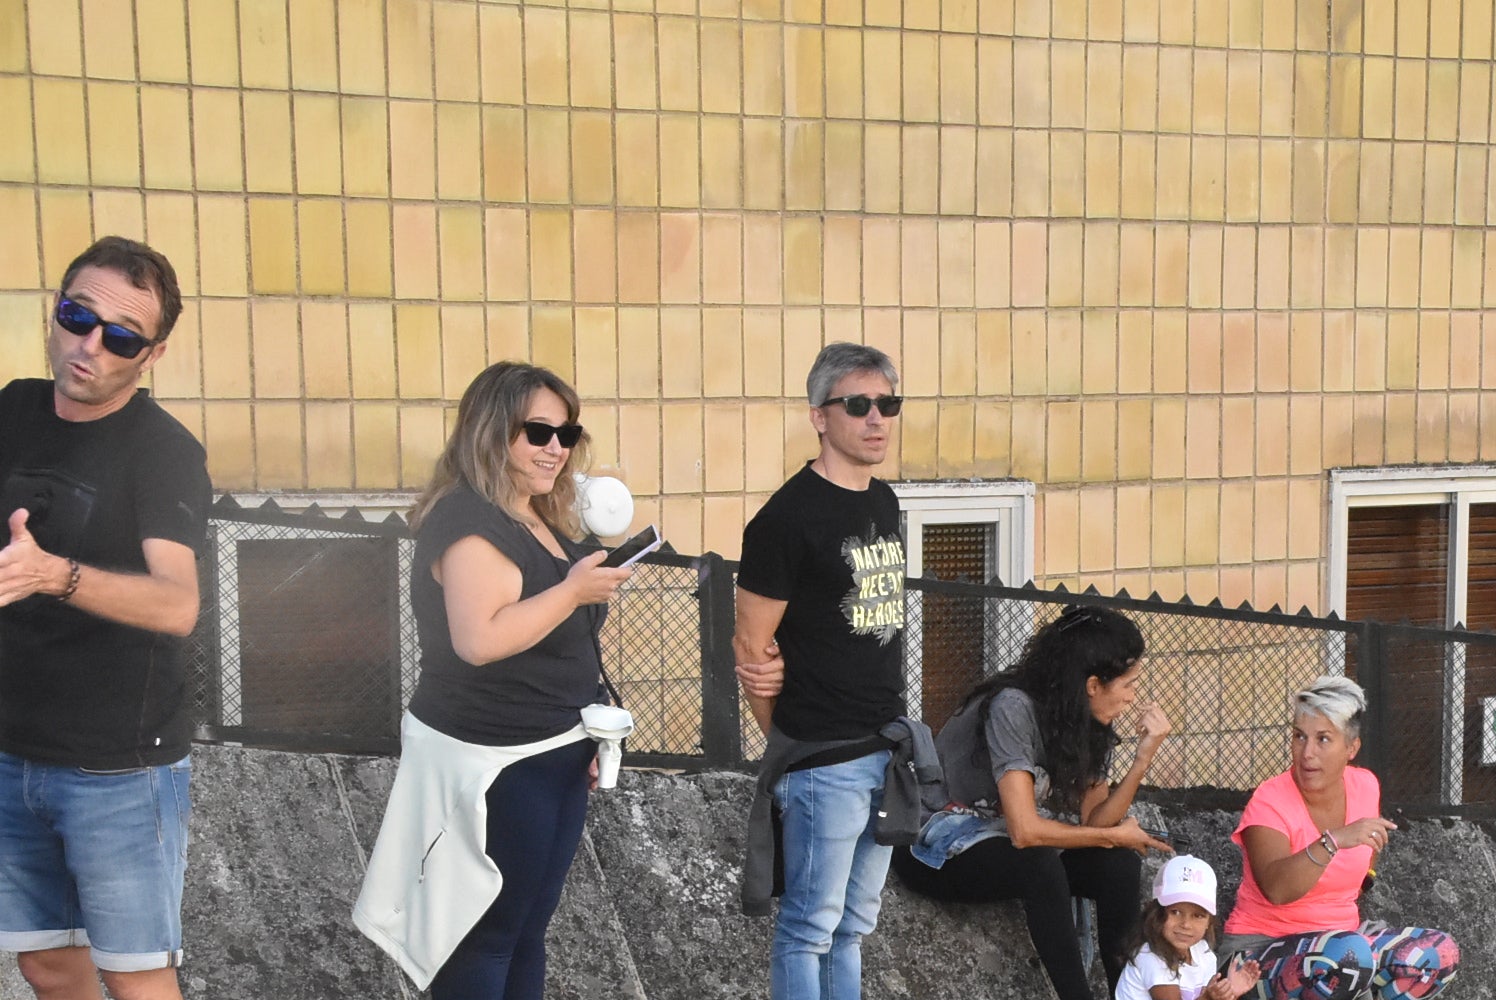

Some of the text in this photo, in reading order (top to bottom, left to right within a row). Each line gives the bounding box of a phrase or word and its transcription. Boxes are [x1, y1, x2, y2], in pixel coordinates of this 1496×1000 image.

[851, 541, 905, 571] NATURE
[859, 570, 904, 599] NEEDS
[853, 599, 904, 629] HEROES
